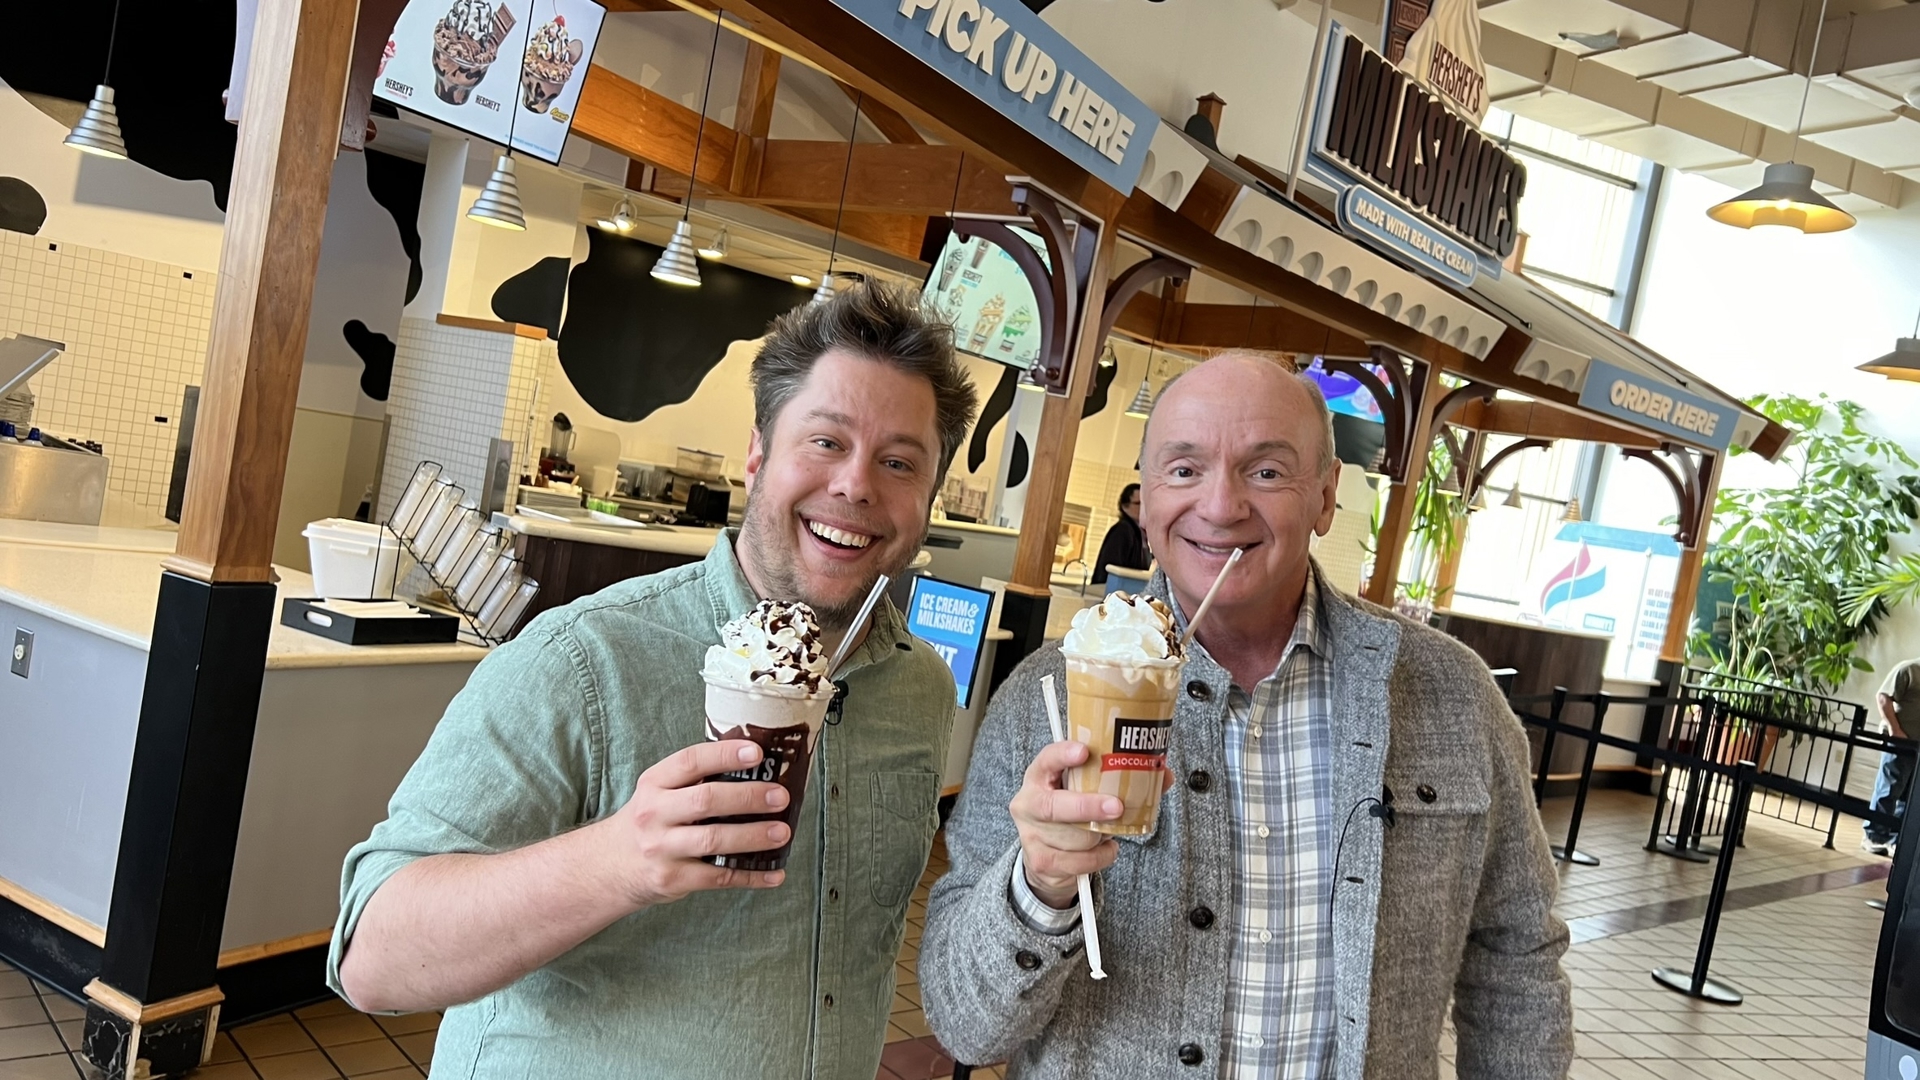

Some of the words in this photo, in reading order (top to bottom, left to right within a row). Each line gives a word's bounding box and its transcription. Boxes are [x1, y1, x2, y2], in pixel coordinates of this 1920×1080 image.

[385, 78, 413, 96] HERSHEY'S
[1429, 41, 1484, 113] HERSHEY'S
[475, 95, 501, 112] HERSHEY'S
[1002, 31, 1057, 103] UP
[1048, 70, 1136, 165] HERE
[1326, 34, 1527, 257] MILKSHAKES
[1355, 198, 1384, 226] MADE
[1386, 214, 1410, 241] WITH
[1410, 230, 1431, 253] REAL
[1432, 240, 1446, 262] ICE
[1446, 251, 1474, 277] CREAM
[1610, 380, 1673, 422] ORDER
[1671, 401, 1719, 438] HERE
[919, 592, 936, 610] ICE
[935, 596, 969, 617] CREAM
[916, 609, 975, 635] MILKSHAKES
[929, 642, 958, 669] IT
[1108, 757, 1155, 767] CHOCOLATE
